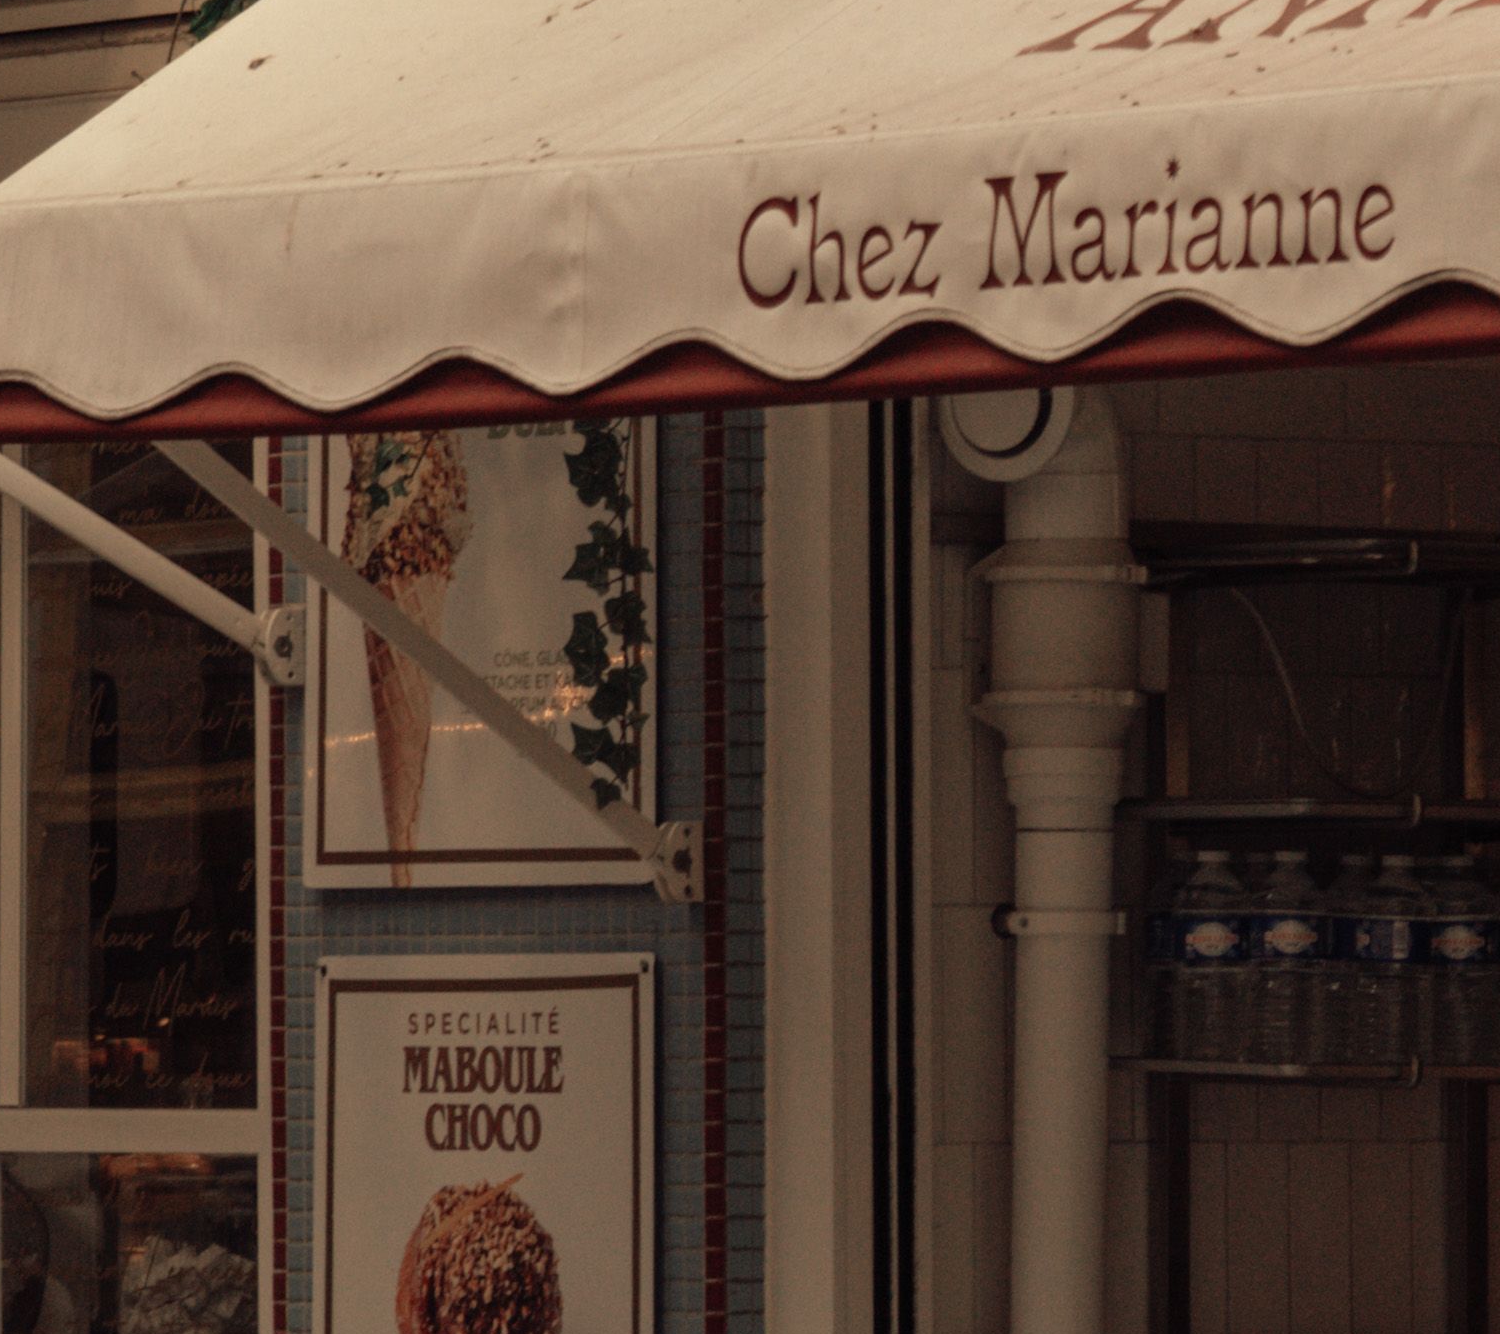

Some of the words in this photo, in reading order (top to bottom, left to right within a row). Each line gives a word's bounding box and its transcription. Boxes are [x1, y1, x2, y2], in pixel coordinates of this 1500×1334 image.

[736, 196, 942, 310] Chez
[978, 160, 1398, 291] Marianne
[406, 1006, 562, 1037] SPECIALITÉ
[401, 1044, 566, 1096] MABOULE
[423, 1101, 543, 1155] CHOCO
